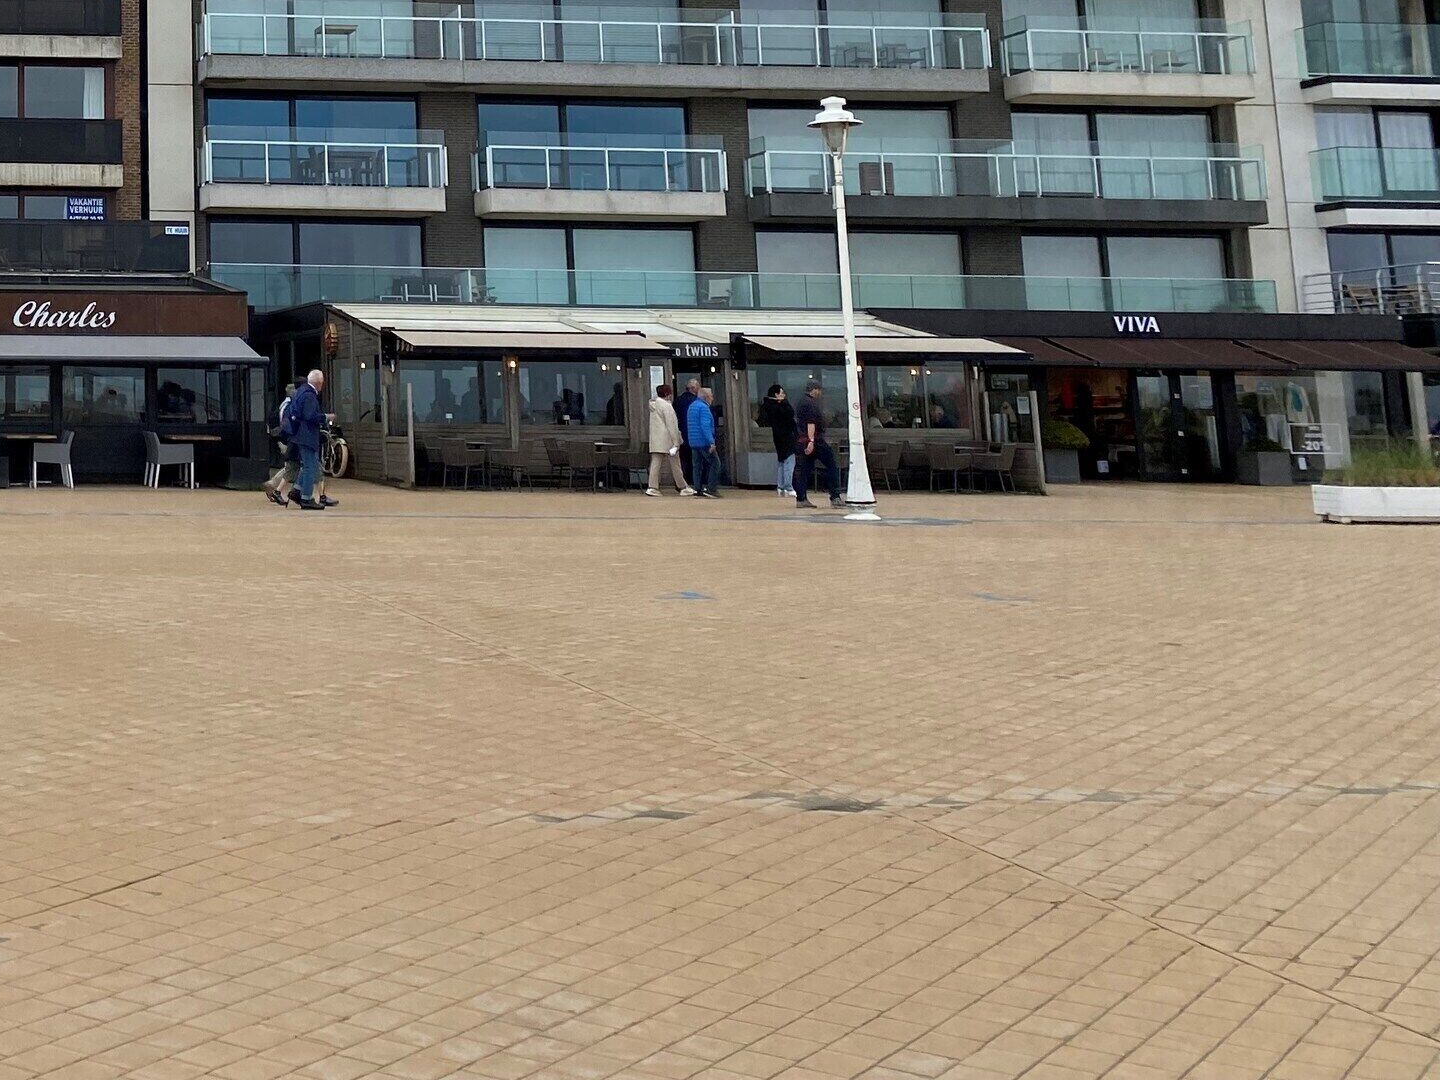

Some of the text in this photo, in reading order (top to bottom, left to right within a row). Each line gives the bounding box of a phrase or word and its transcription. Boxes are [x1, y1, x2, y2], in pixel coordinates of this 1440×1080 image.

[69, 198, 104, 207] VAKANTIE
[69, 206, 104, 215] VERHUUR
[13, 300, 116, 328] Charles
[1113, 315, 1161, 333] VIVA
[685, 343, 719, 357] twins
